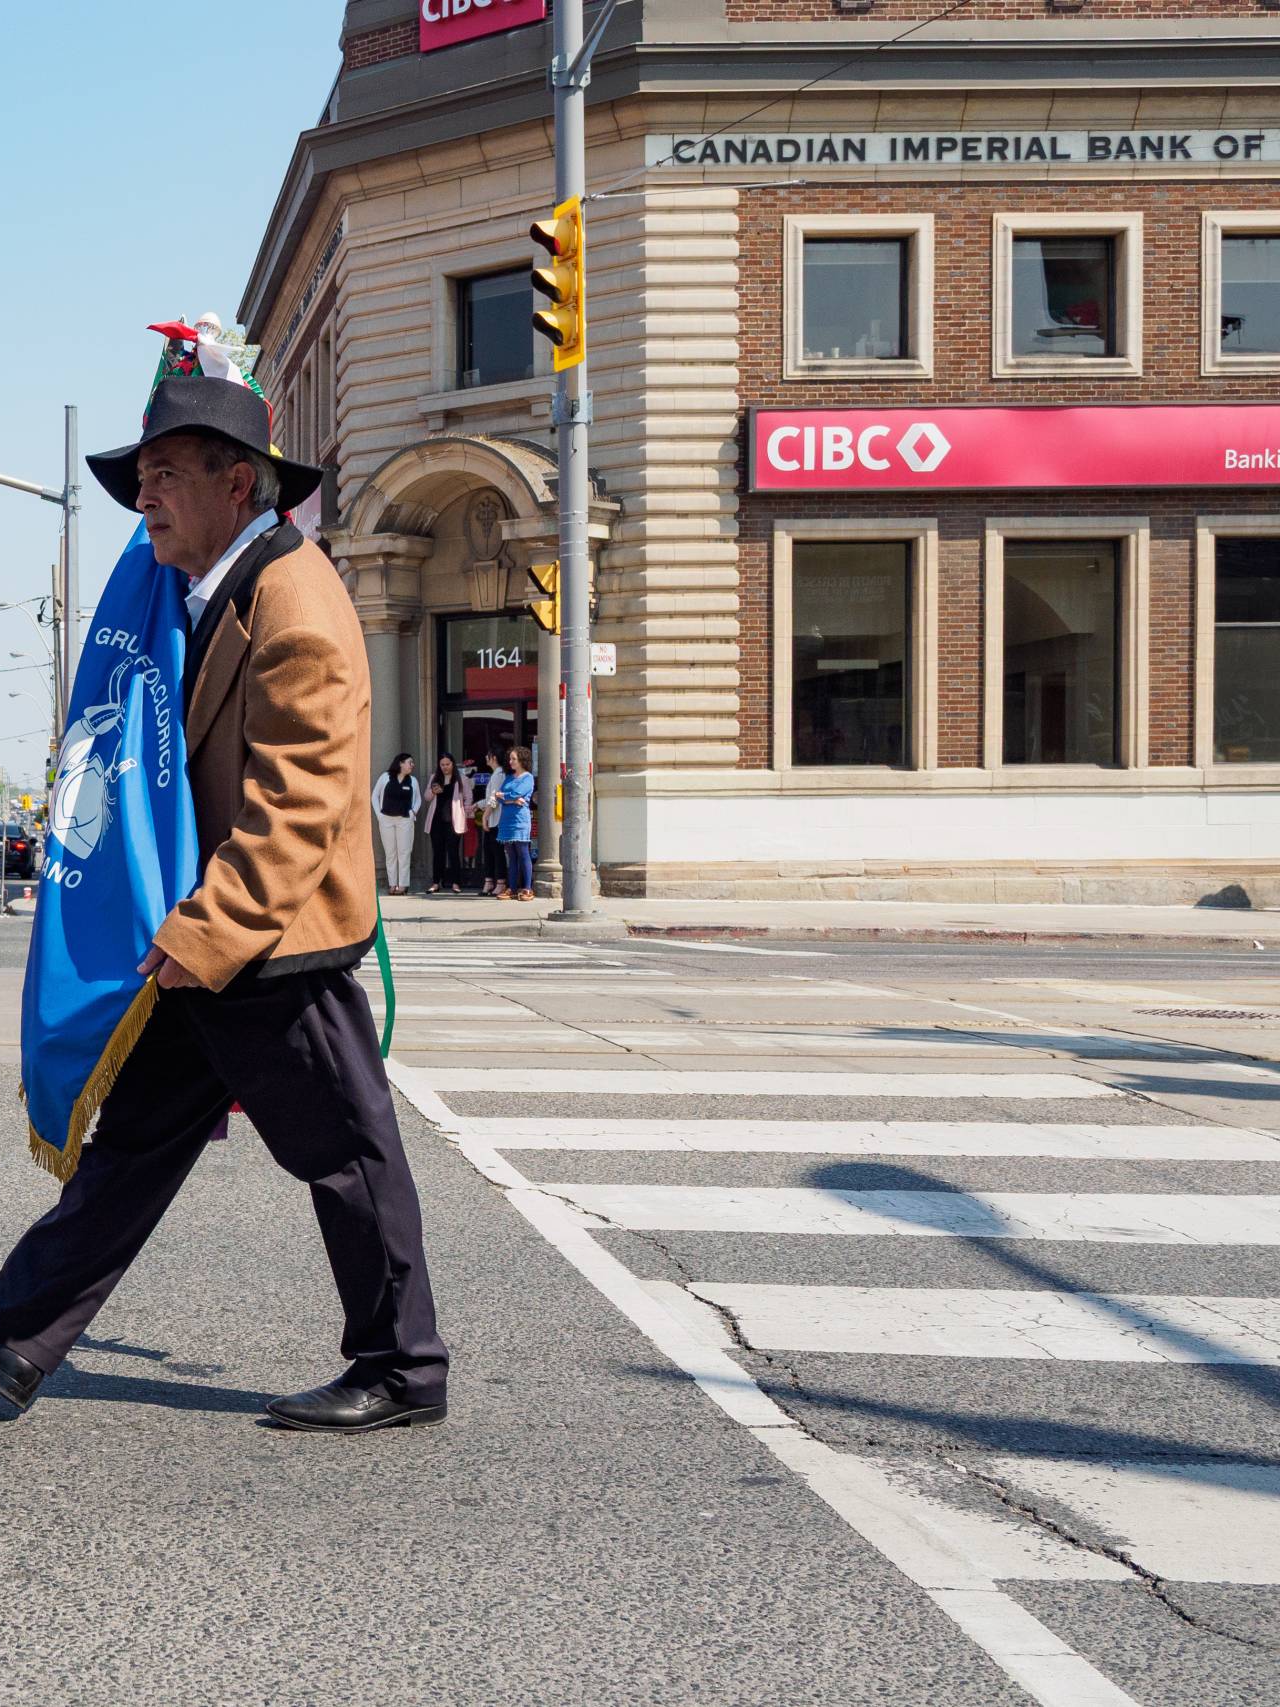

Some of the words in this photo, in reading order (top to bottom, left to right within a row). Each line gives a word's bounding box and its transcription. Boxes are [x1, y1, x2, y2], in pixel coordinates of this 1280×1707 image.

[673, 138, 866, 163] CANADIAN
[889, 136, 1071, 162] IMPERIAL
[1088, 135, 1192, 160] BANK
[1214, 135, 1265, 159] OF
[767, 425, 891, 471] CIBC
[477, 646, 521, 669] 1164
